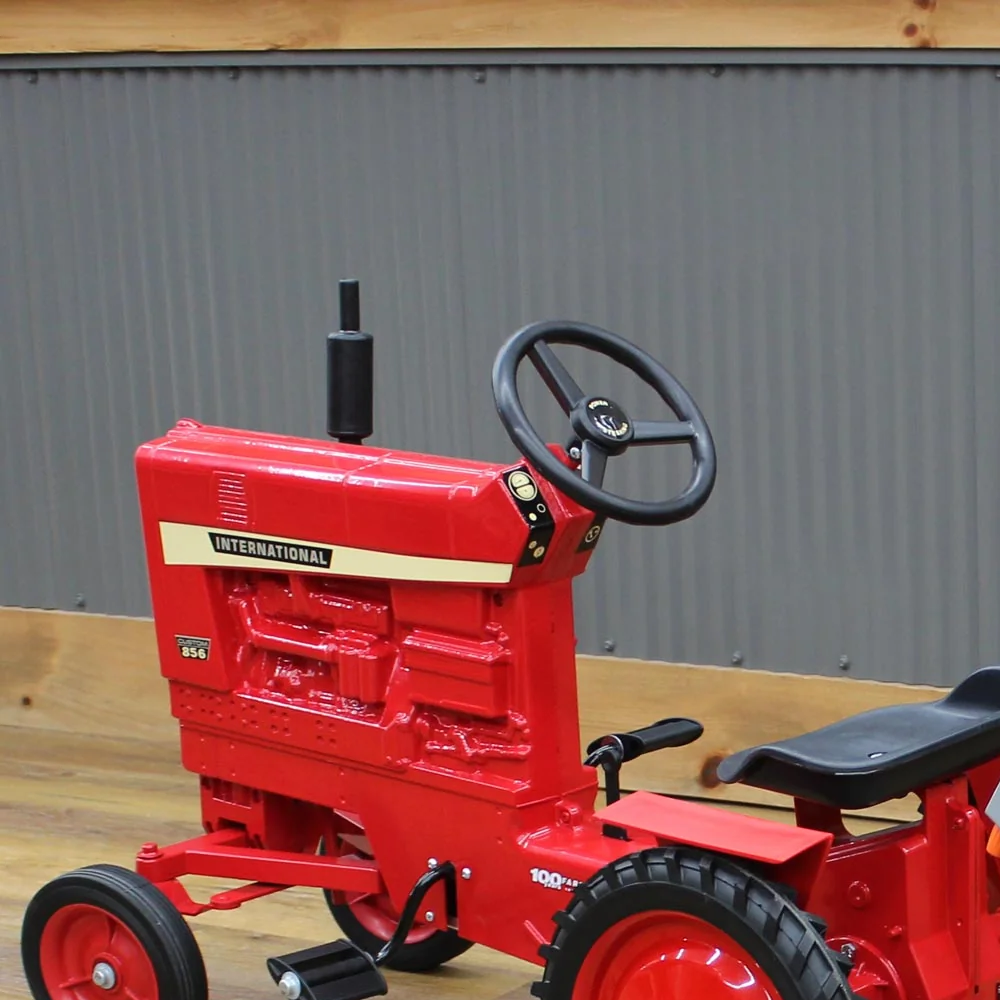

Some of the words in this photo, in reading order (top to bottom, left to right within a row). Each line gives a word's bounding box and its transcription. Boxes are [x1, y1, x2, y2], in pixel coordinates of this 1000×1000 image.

[215, 536, 328, 565] INTERNATIONAL
[181, 646, 207, 659] 856
[530, 868, 562, 887] 100
[561, 877, 583, 887] FAR
